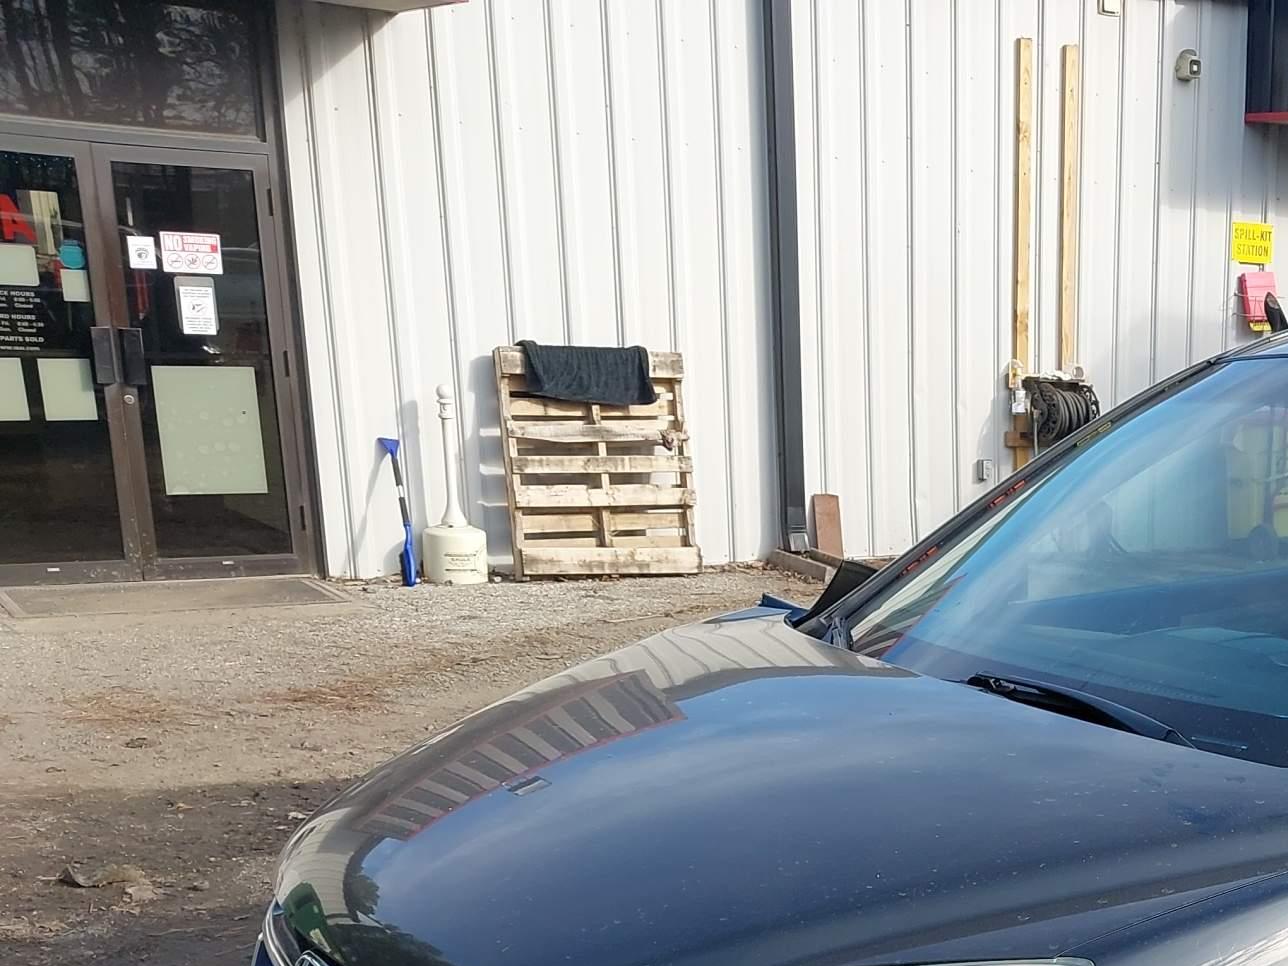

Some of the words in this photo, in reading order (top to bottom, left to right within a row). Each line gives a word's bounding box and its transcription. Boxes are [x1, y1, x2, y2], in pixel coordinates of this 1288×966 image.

[163, 233, 183, 251] NO
[1234, 228, 1272, 242] SPILL-KIT
[1237, 244, 1269, 257] STATION
